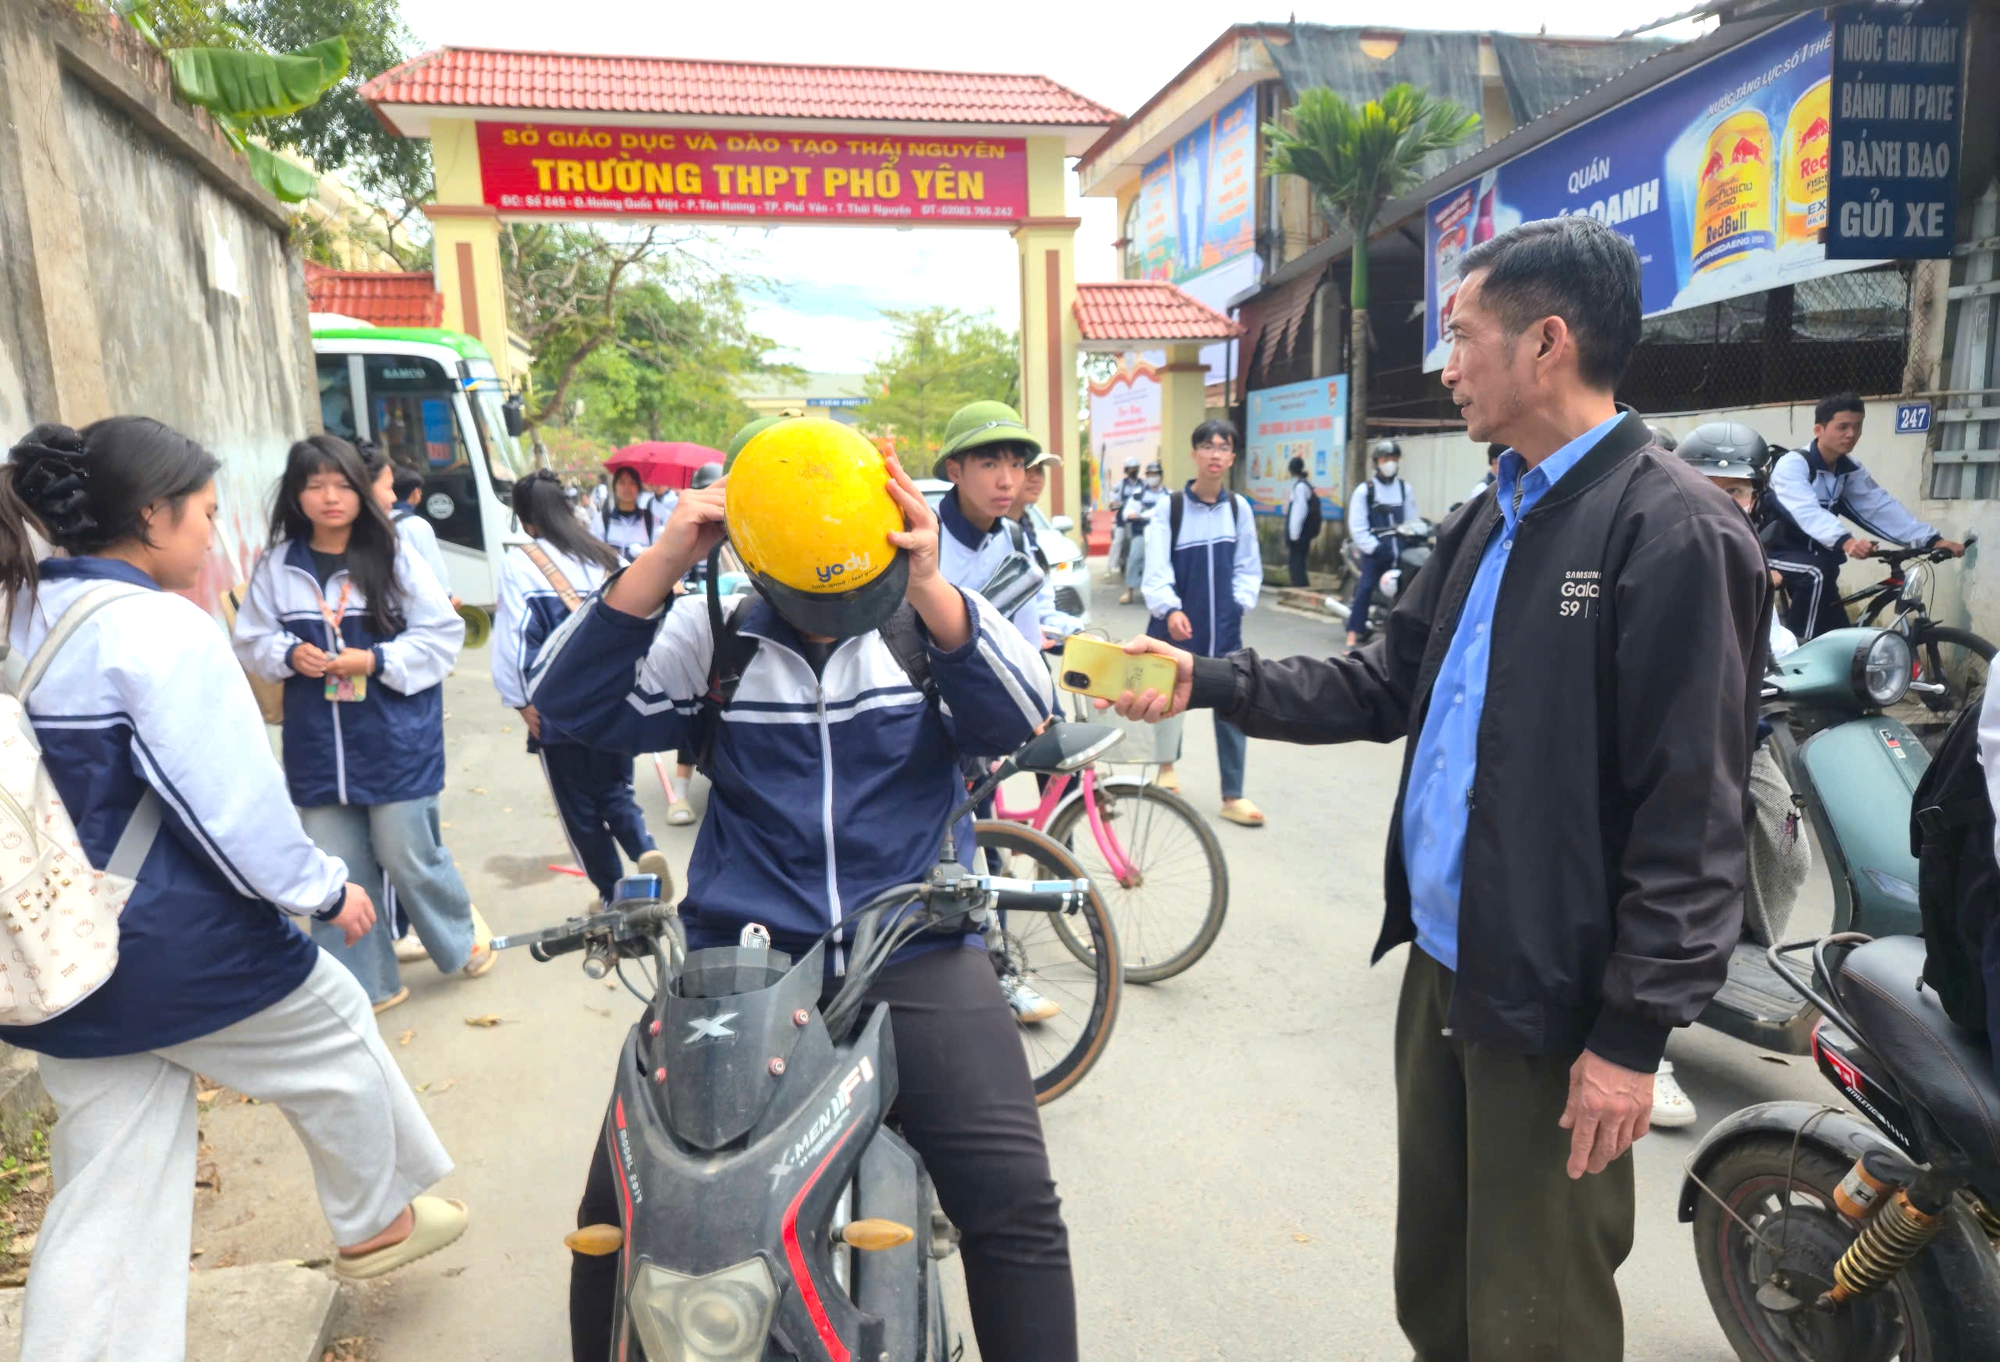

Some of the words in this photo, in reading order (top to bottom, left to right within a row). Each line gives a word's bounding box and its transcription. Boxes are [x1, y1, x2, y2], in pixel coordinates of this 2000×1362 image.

[1843, 13, 1883, 62] NƯỚC
[1888, 12, 1916, 63] GIẢI
[1919, 19, 1959, 63] KHÁT
[1735, 77, 1761, 100] TĂNG
[1762, 64, 1783, 87] LỰC
[1801, 43, 1809, 62] 1
[1841, 71, 1886, 119] BÁNH
[1914, 85, 1955, 121] PATE
[502, 124, 540, 146] SỞ
[547, 127, 612, 148] GIÁO
[620, 132, 676, 153] DỤC
[683, 132, 718, 151] VÀ
[727, 133, 780, 153] ĐÀO
[789, 138, 838, 159] TẠO
[908, 141, 1006, 159] NGUYÊN
[1841, 129, 1902, 177] BÁNH
[1906, 141, 1951, 178] BAO
[531, 151, 703, 195] TRƯỜNG
[712, 164, 811, 197] THPT
[823, 156, 902, 199] PHỔ
[911, 162, 985, 201] YÊN
[1568, 157, 1610, 194] QUÁN
[1840, 187, 1894, 238] GỬI
[1904, 202, 1945, 238] XE
[1901, 408, 1926, 428] 247
[816, 552, 870, 583] yody
[1565, 571, 1601, 579] SAMSUN
[1559, 600, 1580, 616] S9
